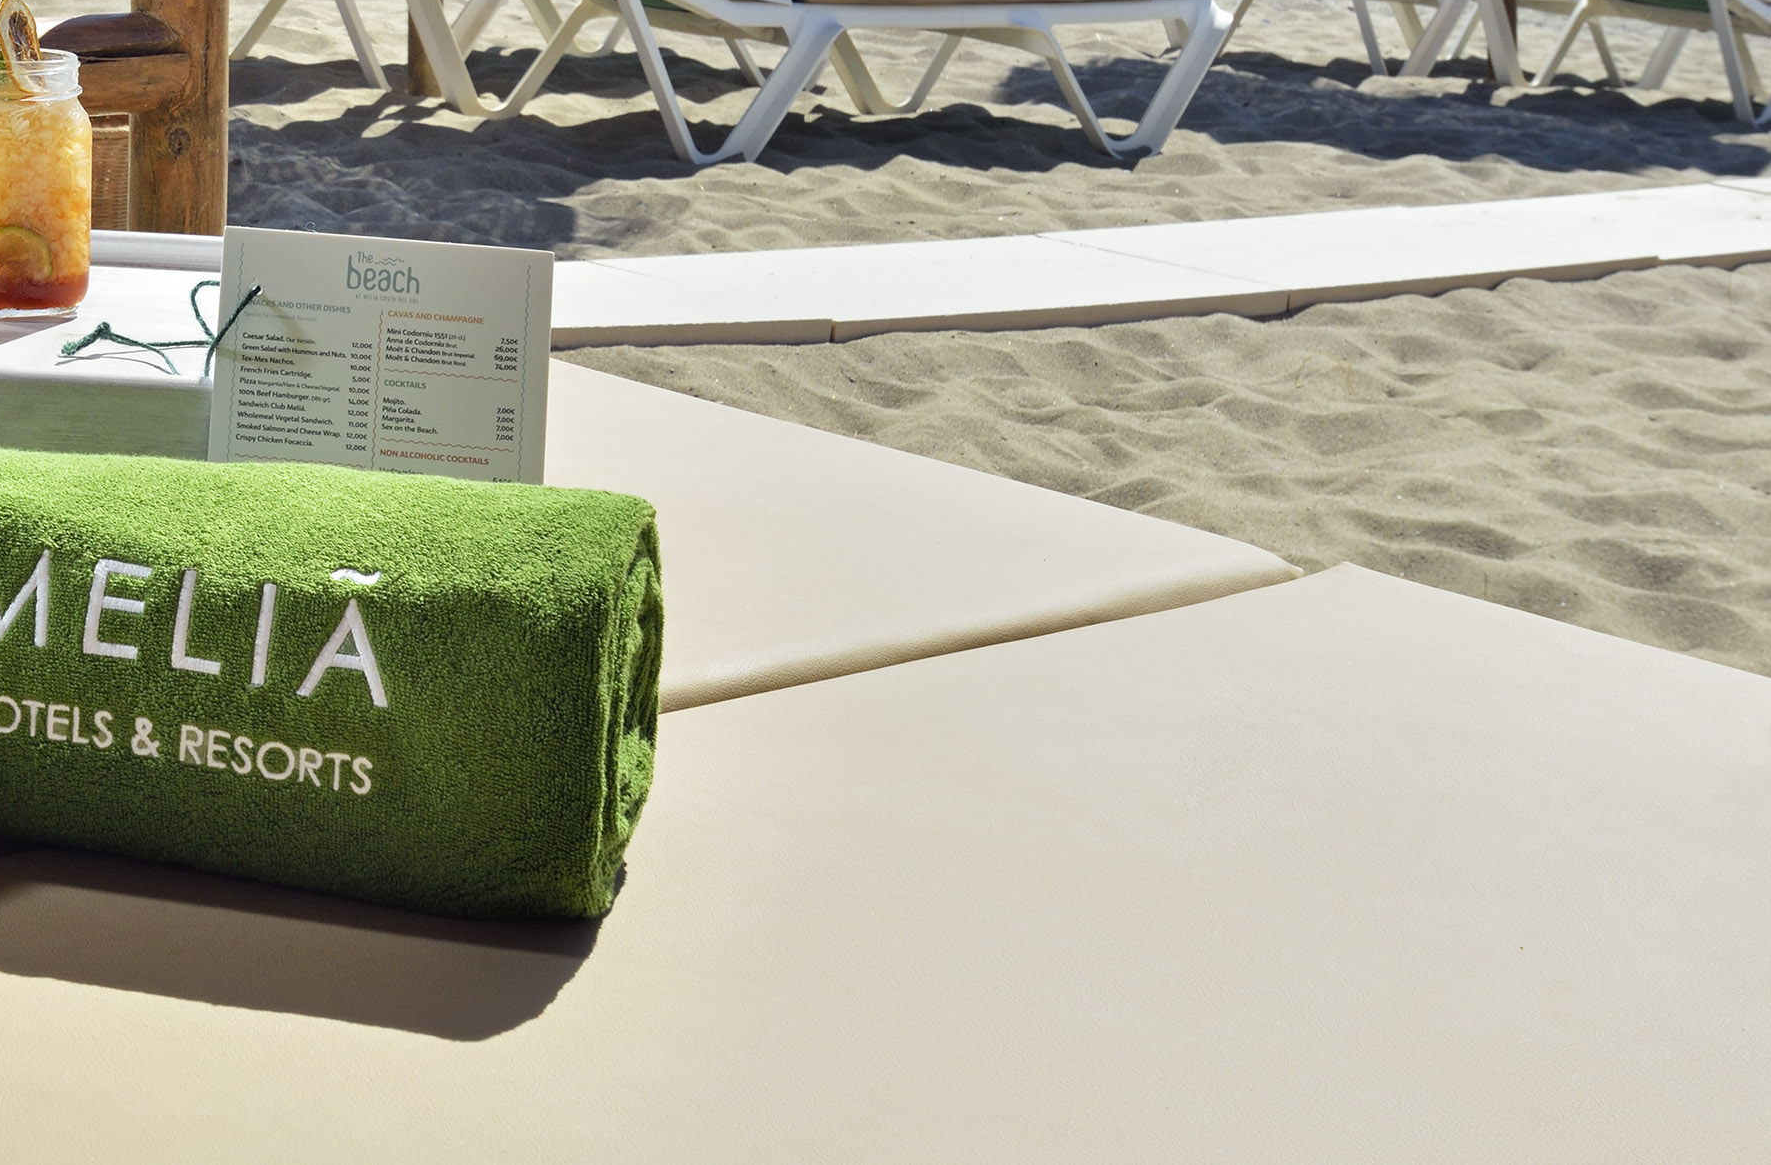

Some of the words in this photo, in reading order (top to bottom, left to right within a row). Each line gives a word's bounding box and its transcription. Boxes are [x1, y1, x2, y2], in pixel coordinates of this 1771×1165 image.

[357, 251, 374, 264] The
[346, 255, 420, 295] beach
[246, 297, 276, 308] NACKS
[278, 301, 294, 309] AND
[295, 302, 322, 311] OTHER
[323, 305, 352, 314] DISHES
[387, 310, 414, 318] CAVAS
[433, 314, 484, 325] CHAMPAGNE
[242, 332, 264, 340] Caesar
[434, 332, 448, 340] 1551
[241, 344, 259, 352] Green
[260, 345, 277, 353] Salad
[277, 346, 291, 354] with
[292, 348, 318, 356] Hummus
[411, 347, 441, 356] Chandon
[241, 355, 268, 364] Tex-Mex
[269, 357, 296, 365] Nachos.
[410, 355, 441, 365] Chandon
[240, 366, 262, 374] French
[263, 368, 278, 376] Fries
[280, 369, 313, 379] Cartridge.
[239, 377, 257, 385] Pizza
[384, 379, 426, 389] COCKTAILS
[256, 390, 271, 398] Beef
[272, 391, 311, 401] Hamburger.
[238, 399, 269, 408] Sandwich
[270, 402, 286, 410] Club
[383, 397, 406, 406] Mojito.
[382, 406, 397, 414] Piña
[398, 407, 422, 416] Colada.
[237, 411, 274, 420] Wholemeal
[275, 414, 300, 424] Vegetal
[300, 416, 334, 425] Sandwich.
[382, 415, 416, 424] Margarita.
[236, 422, 262, 431] Smoked
[262, 425, 286, 433] Salmon
[299, 428, 322, 437] Cheese
[323, 430, 342, 439] Wrap.
[381, 423, 393, 431] Sex
[404, 425, 415, 433] the
[417, 427, 439, 435] Beach.
[235, 433, 256, 443] Crispy
[257, 435, 283, 444] Chicken
[284, 438, 314, 447] Focaccia.
[380, 449, 399, 457] NON
[399, 451, 445, 462] ALCOHOLIC
[446, 454, 490, 465] COCKTAILS
[130, 717, 159, 758] &
[179, 724, 373, 794] RESORTS
